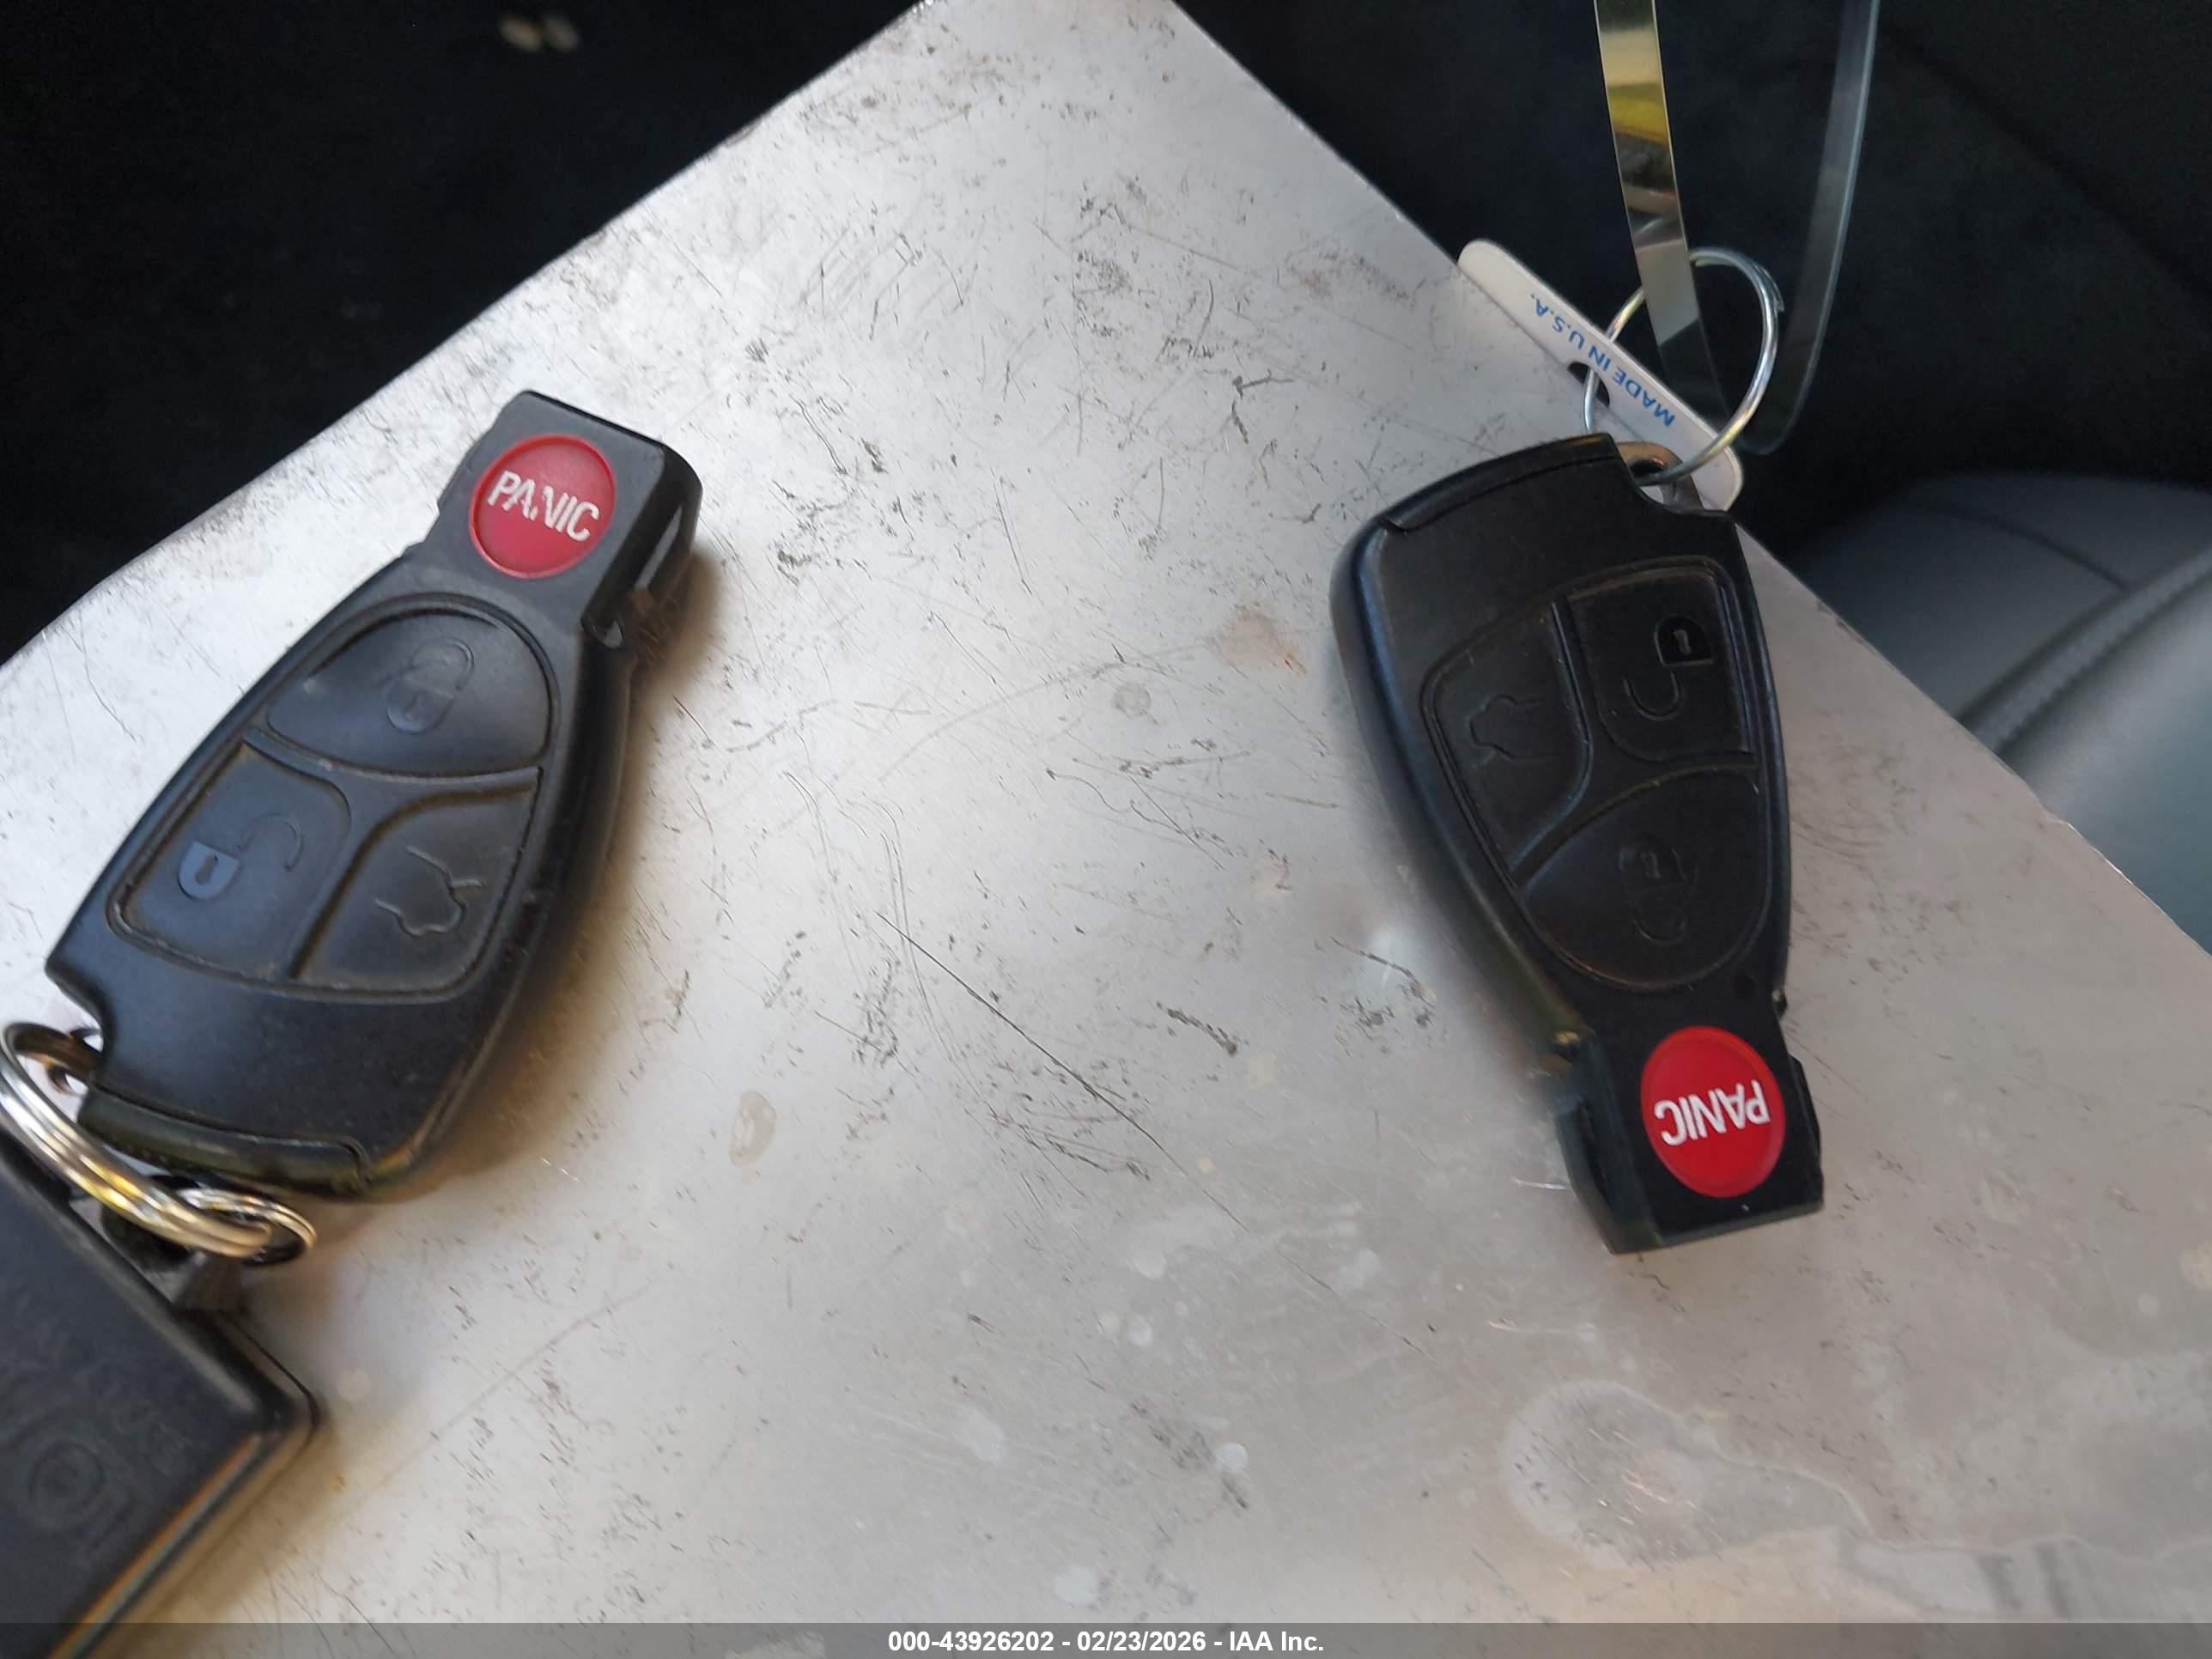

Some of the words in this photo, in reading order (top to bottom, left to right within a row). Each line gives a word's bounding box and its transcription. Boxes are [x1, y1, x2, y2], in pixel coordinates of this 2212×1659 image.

[1530, 293, 1585, 350] U.S.A.
[1589, 345, 1612, 366] IN
[1611, 367, 1674, 427] MADE
[488, 471, 599, 542] PANIC
[1654, 1079, 1771, 1146] PANIC
